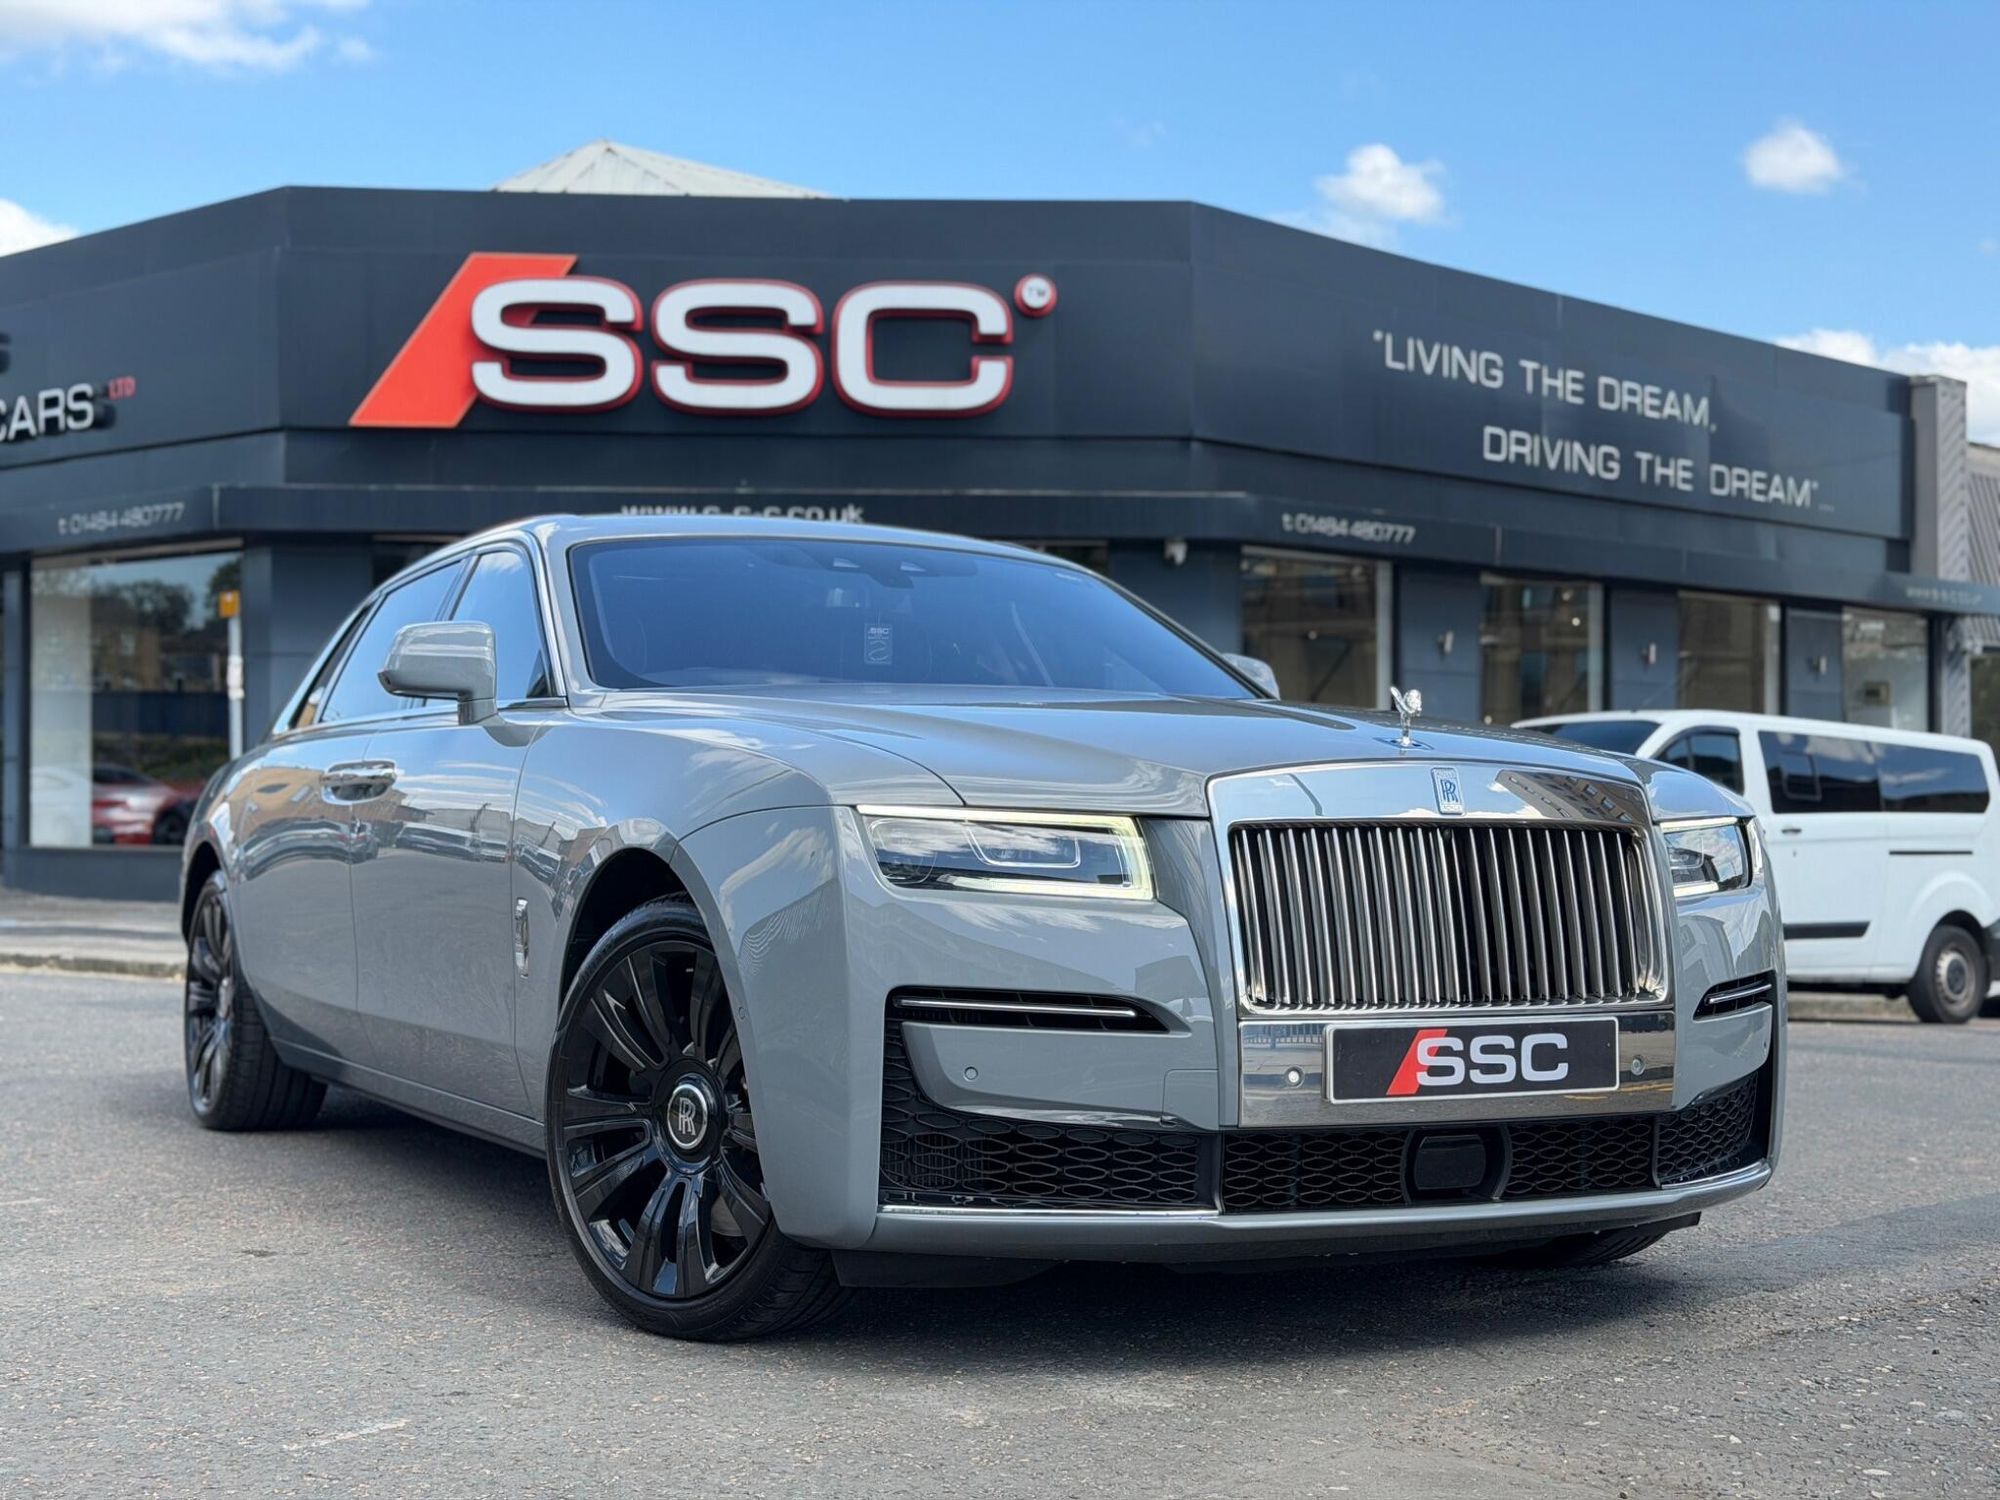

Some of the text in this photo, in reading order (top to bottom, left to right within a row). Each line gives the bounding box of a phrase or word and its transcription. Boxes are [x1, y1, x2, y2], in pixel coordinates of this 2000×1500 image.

[470, 277, 1013, 418] SSC
[0, 376, 136, 441] ARS LTD
[1519, 359, 1585, 405] THE
[1598, 376, 1717, 433] DREAM,
[1483, 425, 1621, 481] DRIVING
[1634, 451, 1694, 492] THE
[1416, 1033, 1569, 1086] SSC
